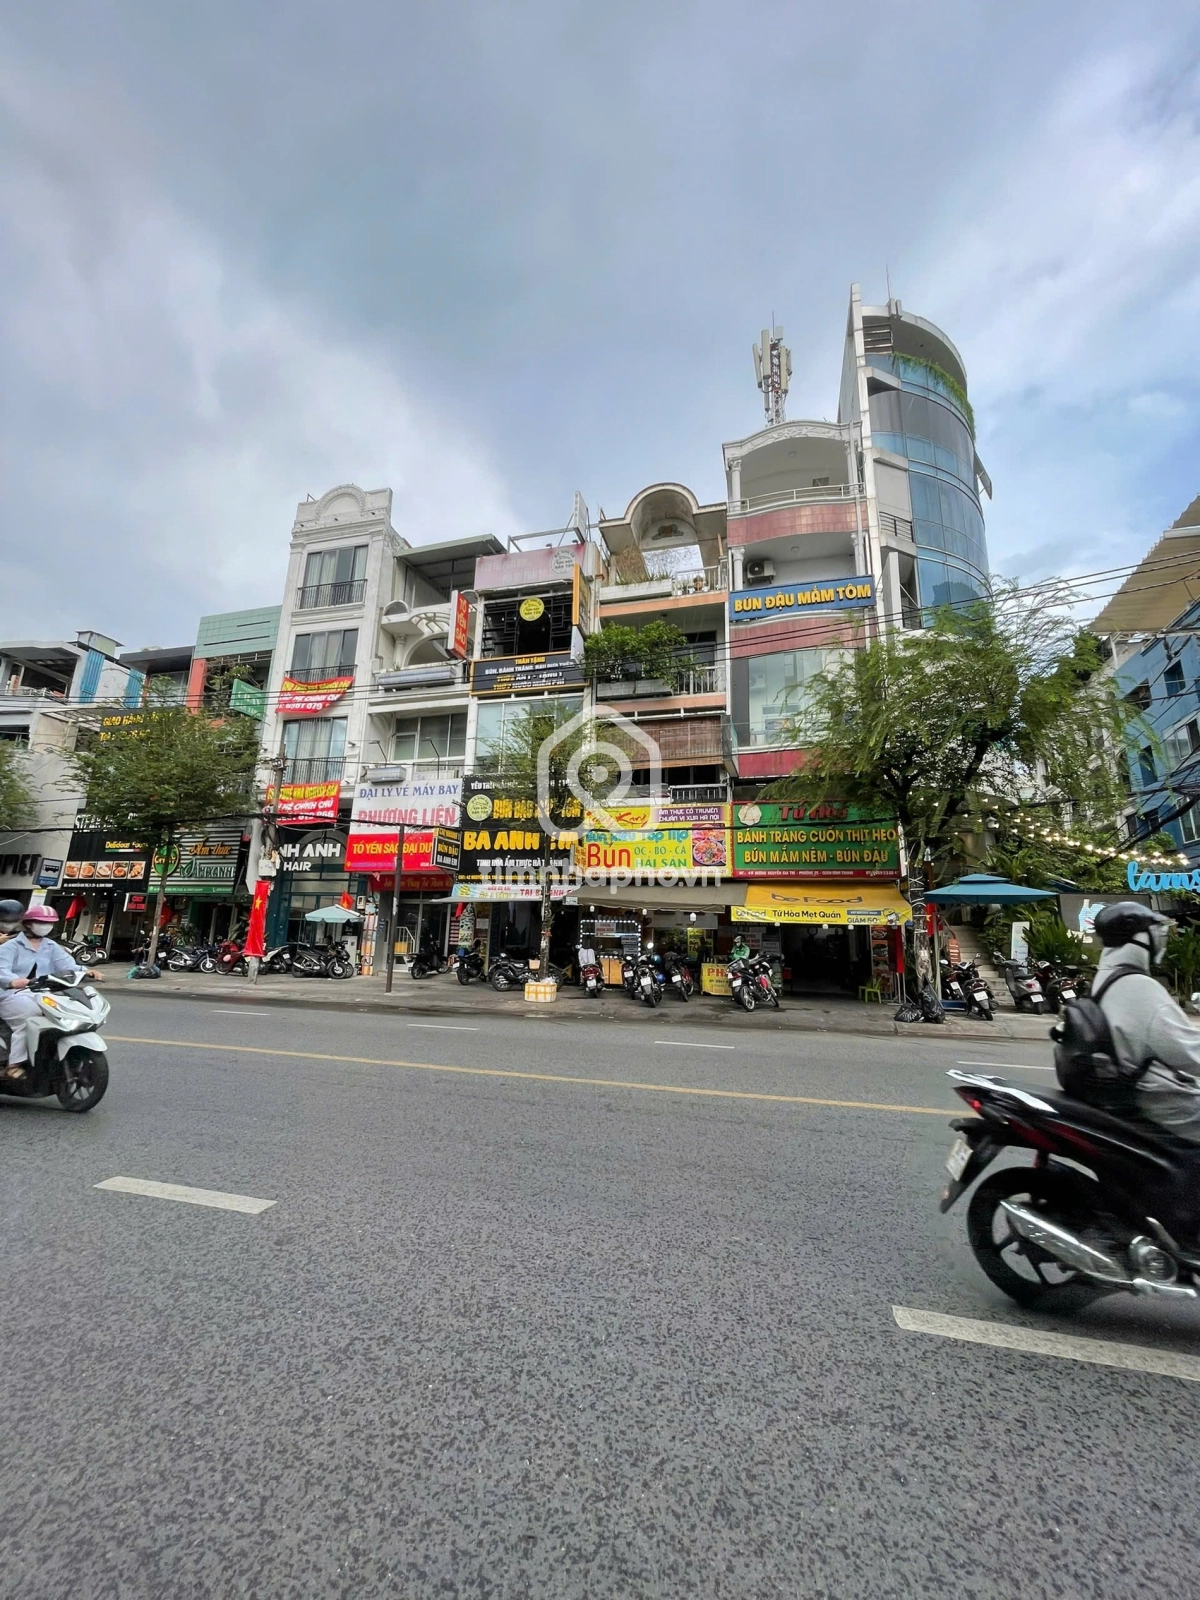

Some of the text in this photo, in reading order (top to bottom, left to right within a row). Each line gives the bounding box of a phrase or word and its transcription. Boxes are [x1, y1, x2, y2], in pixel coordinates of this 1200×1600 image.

[734, 583, 871, 612] BÚN ĐẬU MẮM TÔM
[360, 788, 378, 800] ĐẠI
[382, 784, 393, 797] LÝ
[413, 783, 436, 796] MÁY
[438, 784, 458, 794] BAY
[357, 808, 418, 827] PHƯƠNG
[422, 804, 456, 826] LIÊN
[464, 830, 491, 850] BA
[494, 830, 540, 850] ANH
[737, 826, 897, 845] BÁNH TRÁNG CUỐN THỊT HEO
[279, 844, 341, 857] NH ANH
[366, 840, 382, 854] YẾN
[403, 842, 417, 856] ĐẠI
[587, 842, 631, 868] Bún
[744, 847, 767, 863] BÚN
[770, 845, 799, 863] MẮM
[802, 847, 827, 862] NÊM
[836, 847, 860, 862] BÚN
[864, 846, 889, 864] ĐẬU
[284, 862, 312, 871] HAIR
[772, 909, 783, 918] Tứ
[785, 909, 800, 918] Hòa
[801, 910, 818, 920] Mẹt
[819, 910, 841, 918] Quán
